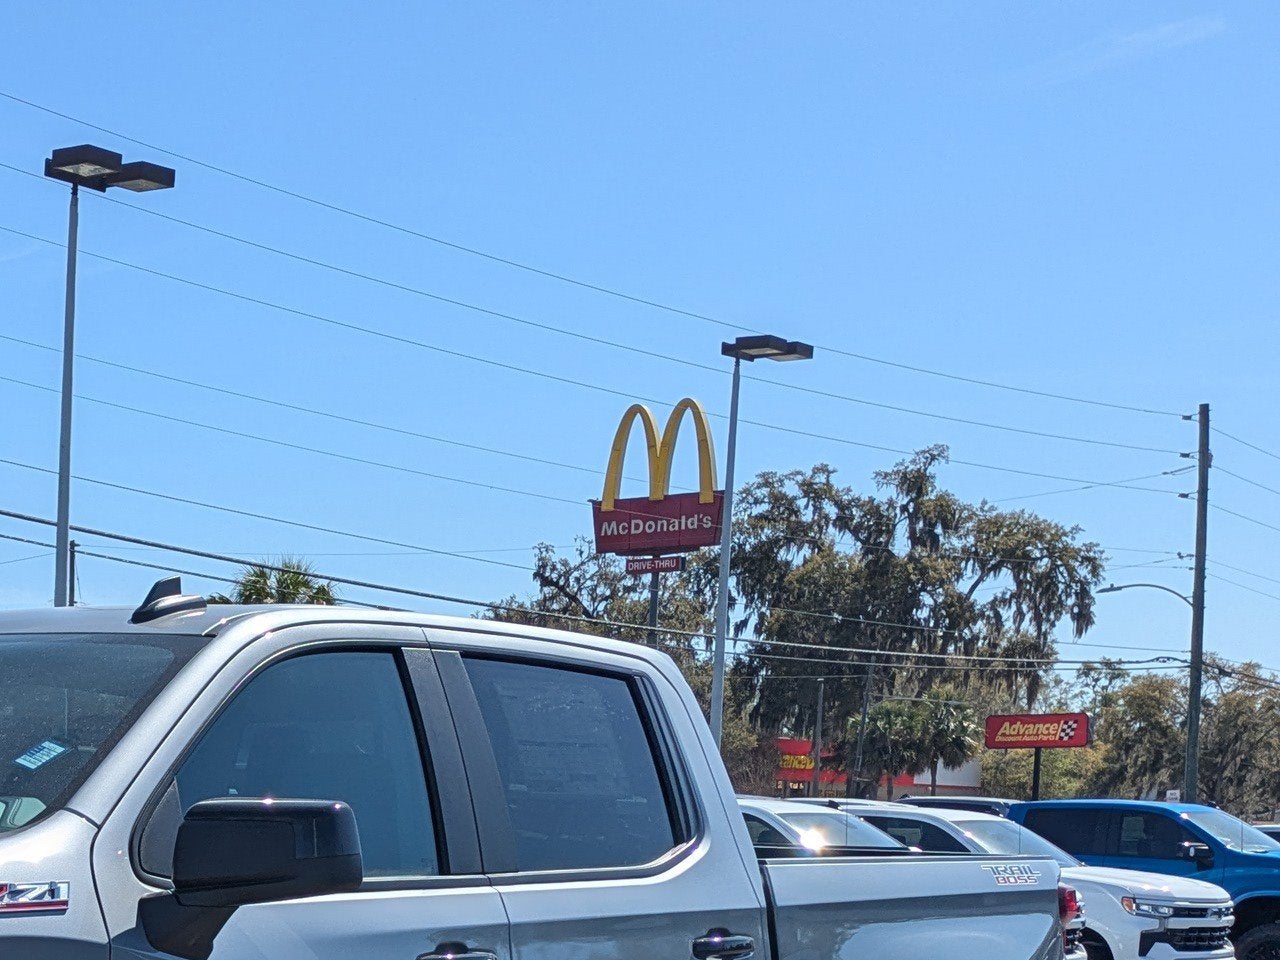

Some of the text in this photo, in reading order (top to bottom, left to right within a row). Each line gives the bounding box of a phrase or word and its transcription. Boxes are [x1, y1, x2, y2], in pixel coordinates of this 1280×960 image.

[600, 513, 712, 536] McDonald's
[627, 558, 677, 571] DRIVE-THRU
[997, 721, 1059, 735] Advance
[981, 864, 1041, 876] TRAIL
[994, 875, 1039, 885] BOSS
